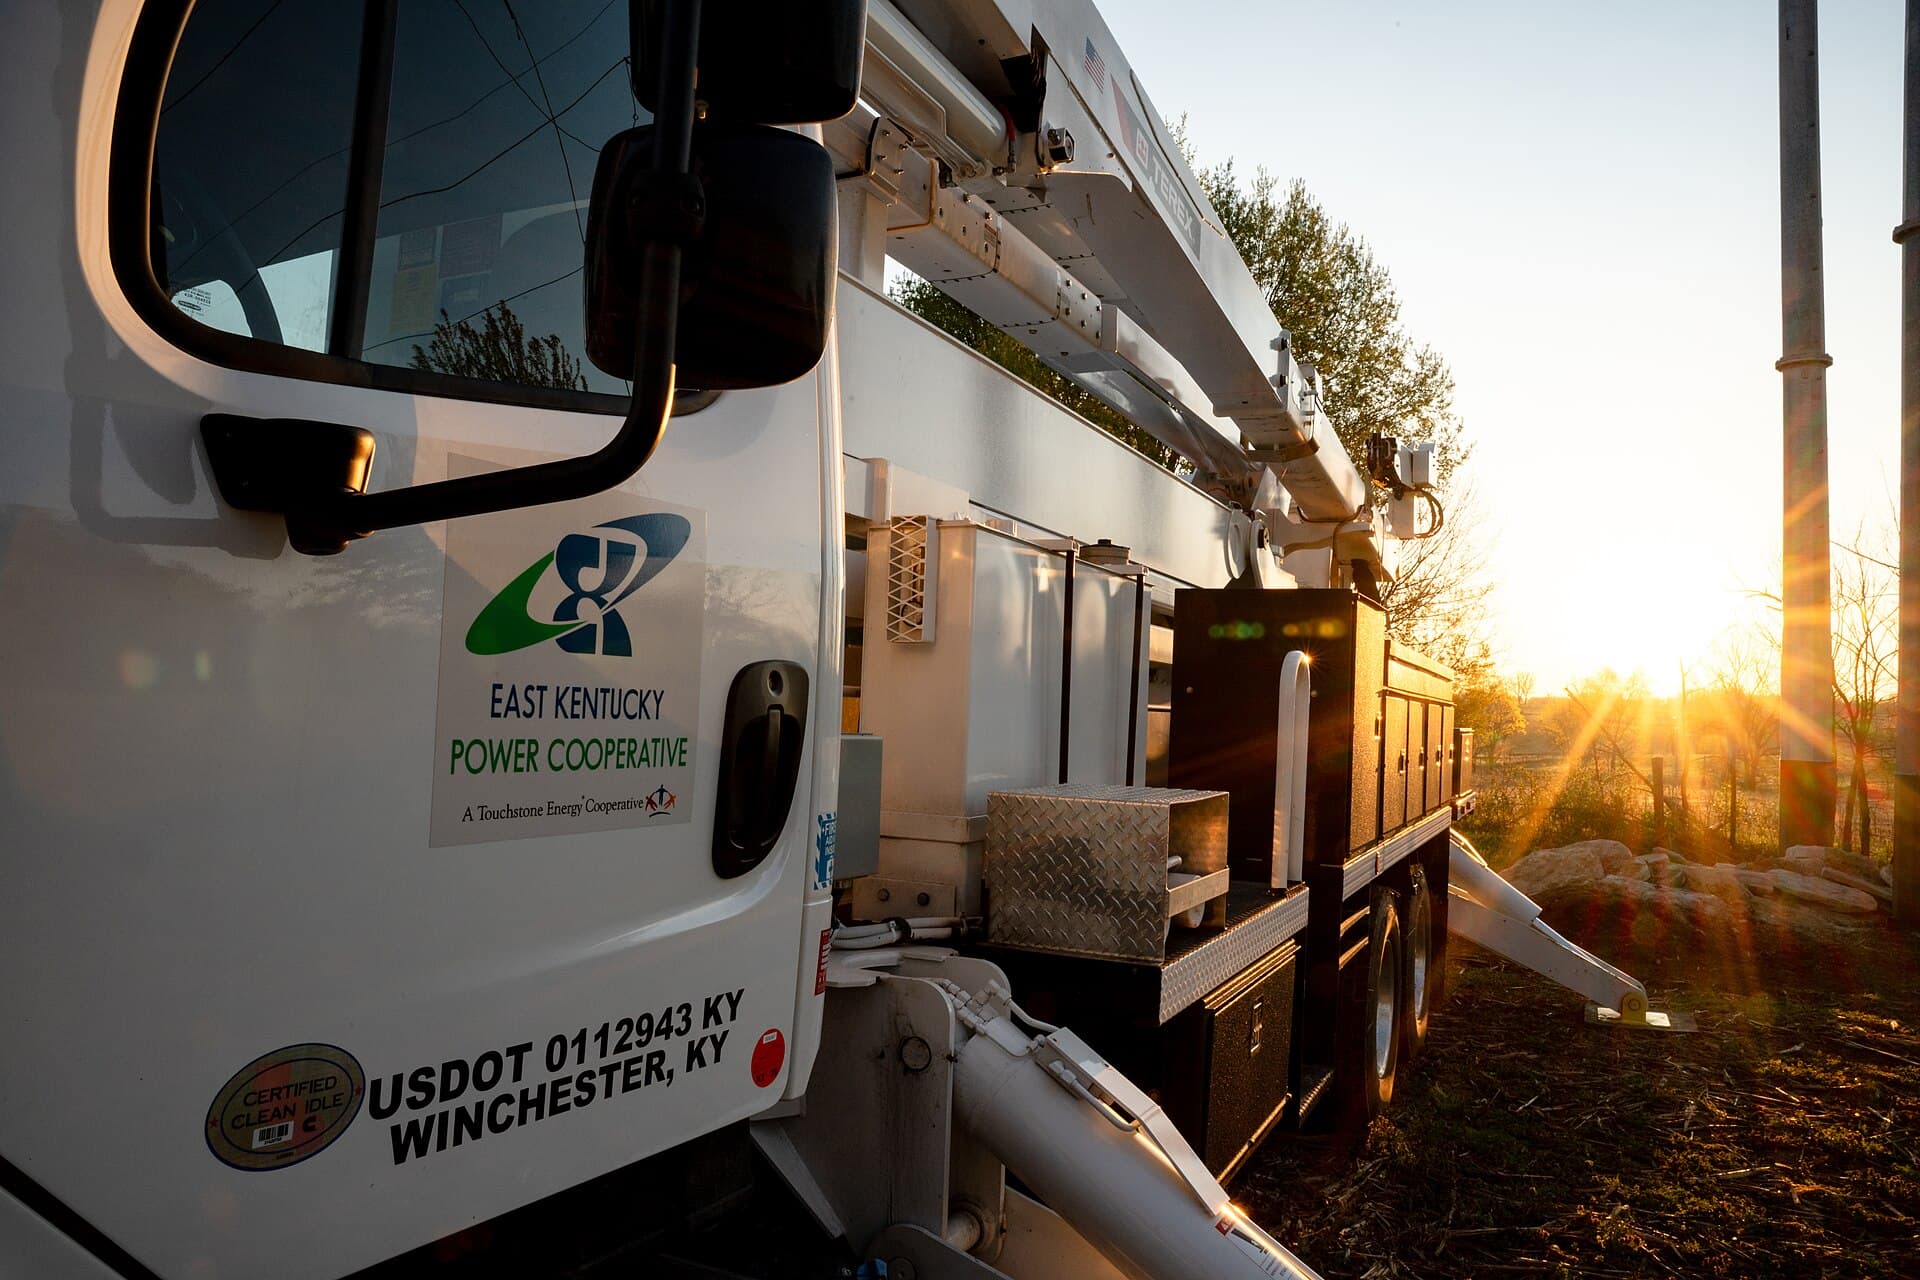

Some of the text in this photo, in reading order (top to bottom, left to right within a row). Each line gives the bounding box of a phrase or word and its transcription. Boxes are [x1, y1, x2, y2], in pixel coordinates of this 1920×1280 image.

[1152, 155, 1194, 240] TEREX
[491, 683, 665, 720] EAST KENTUCKY
[450, 737, 689, 775] POWER COOPERATIVE
[462, 797, 644, 822] A Touchstone Energy Cooperative
[367, 988, 745, 1121] USDOT 0112943 KY
[243, 1075, 337, 1107] CERTIFIED
[389, 1030, 730, 1166] WINCHESTER, KY
[231, 1092, 345, 1130] CLEAN IDLE
